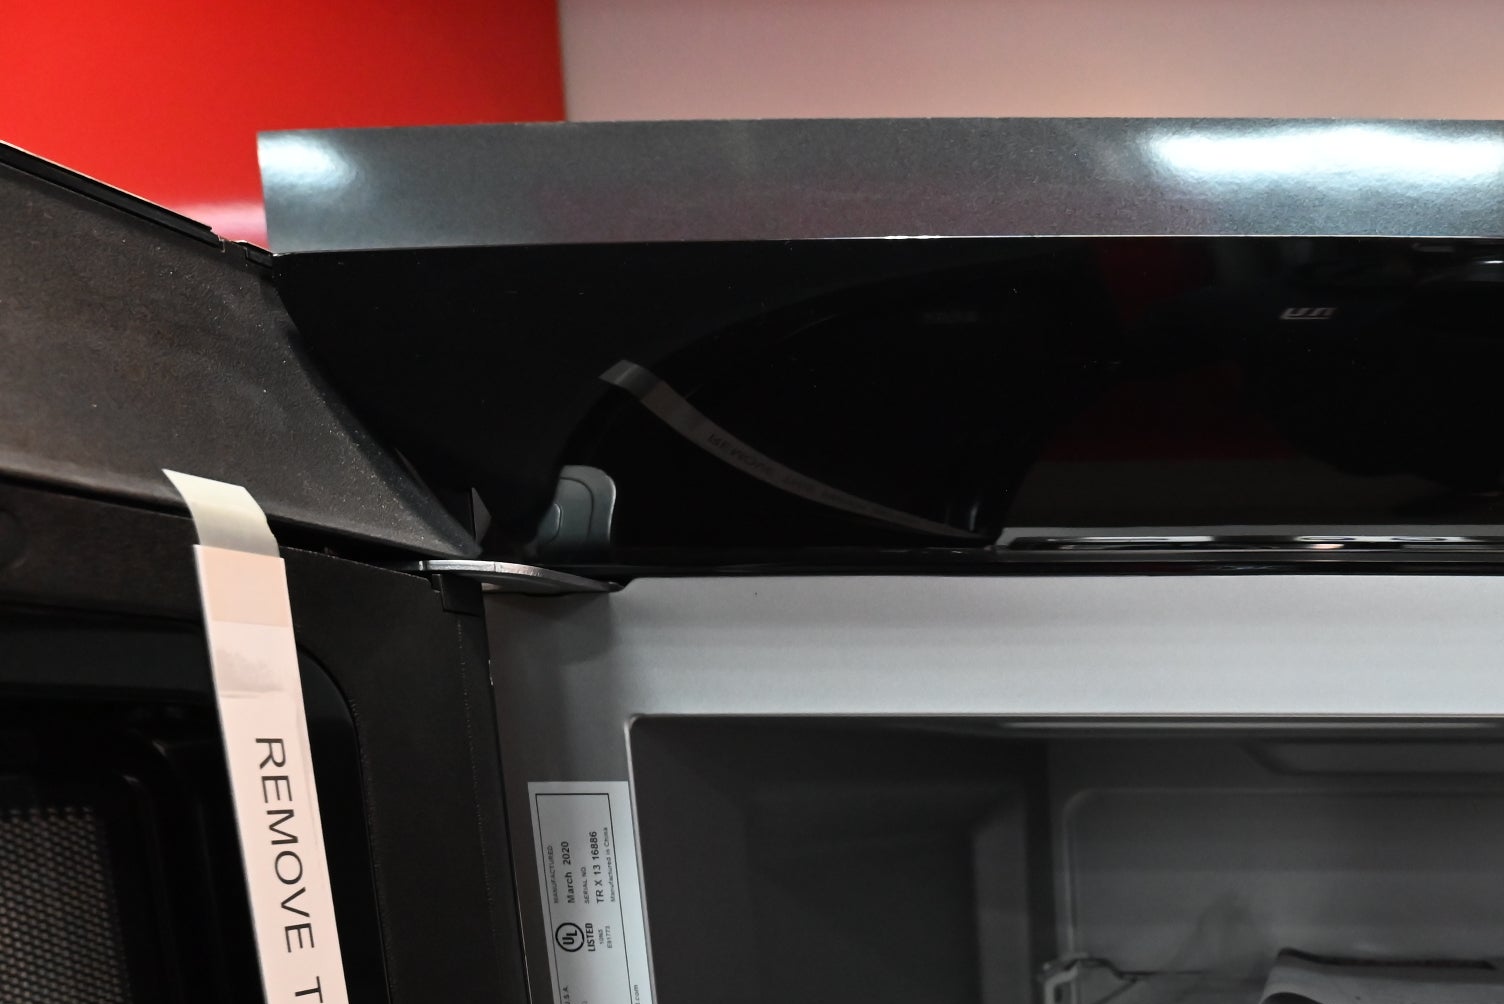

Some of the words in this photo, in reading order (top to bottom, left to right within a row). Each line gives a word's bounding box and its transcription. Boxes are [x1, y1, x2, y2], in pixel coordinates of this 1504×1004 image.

[255, 737, 315, 953] REMOVE
[561, 841, 570, 865] 2020
[590, 831, 599, 859] 16886
[593, 864, 600, 874] 13
[565, 872, 574, 903] March
[596, 890, 604, 903] TR
[585, 922, 595, 951] LISTED
